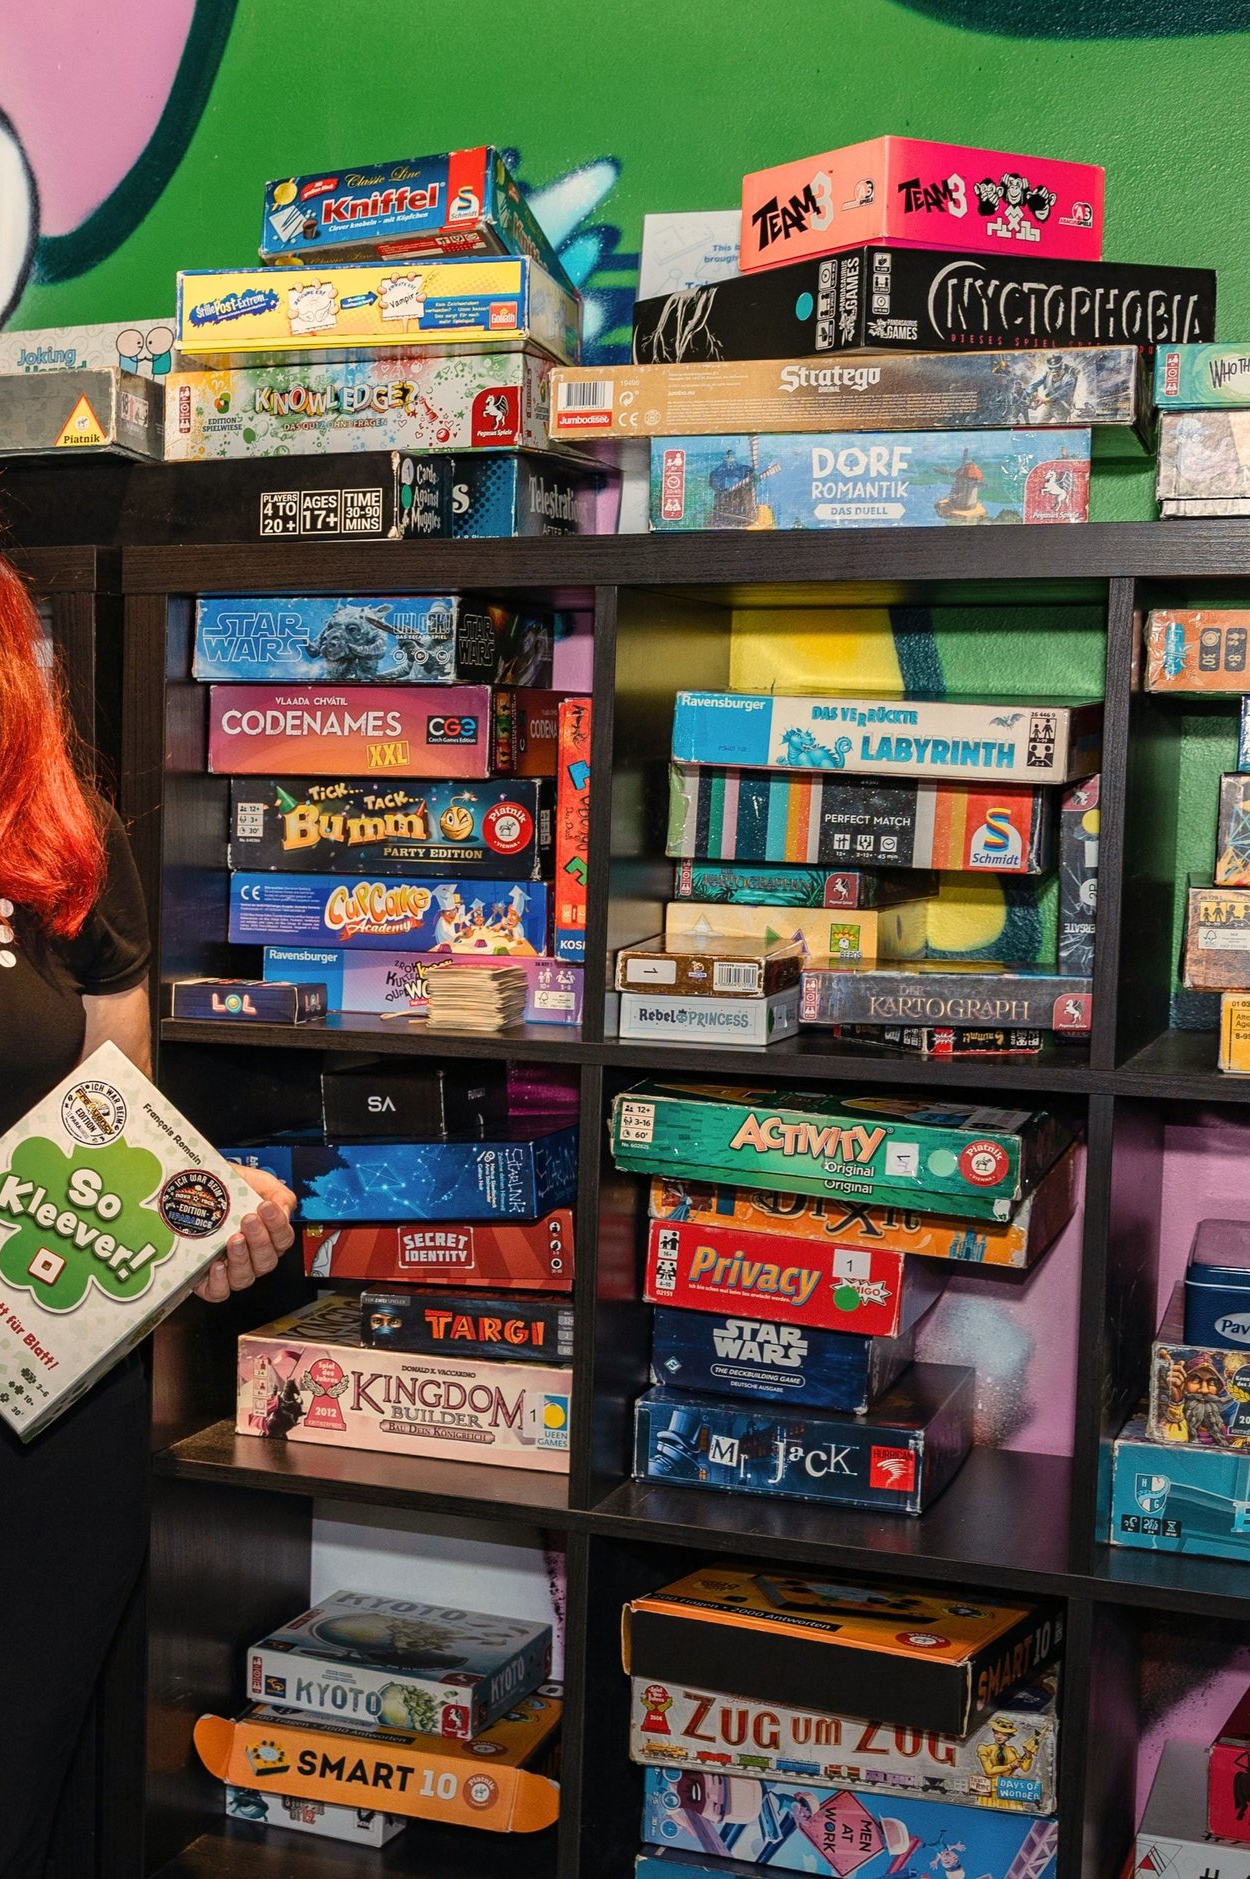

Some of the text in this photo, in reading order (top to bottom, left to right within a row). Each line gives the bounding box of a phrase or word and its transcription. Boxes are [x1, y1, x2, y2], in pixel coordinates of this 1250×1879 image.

[344, 172, 385, 189] Classic
[389, 166, 421, 182] Line
[321, 182, 440, 224] Kniffel
[329, 212, 428, 232] Clever knobeln mit Köpfchen
[450, 210, 478, 220] Schmidt
[712, 244, 733, 252] This
[845, 257, 860, 309] GAMES
[887, 319, 918, 327] PANDASAURUS
[887, 326, 918, 340] GAMES
[16, 346, 77, 367] Joking
[777, 365, 882, 393] Stratego
[254, 380, 421, 417] KNOWLEDGE?
[202, 423, 242, 433] SPIELWIESE
[208, 417, 237, 425] EDITION
[559, 415, 609, 426] Jumbodiset
[63, 433, 101, 444] Piatnik
[812, 446, 912, 478] DORF
[263, 493, 298, 503] PLAYERS
[811, 480, 909, 500] ROMANTIK
[304, 496, 337, 509] AGES
[344, 492, 380, 507] TIME
[263, 502, 297, 516] 4 TO
[346, 507, 380, 518] 30-90
[831, 506, 888, 516] DAS DUELL
[303, 511, 338, 529] 17+
[345, 518, 380, 530] MINS
[203, 612, 310, 637] STAR
[203, 637, 310, 662] WARS
[275, 695, 348, 706] VLAADA CHVÁTIL
[681, 695, 766, 711] Ravensburger
[221, 709, 402, 737] CODENAMES
[811, 706, 919, 728] DAS VERRÜCKTE
[368, 743, 409, 767] XXL
[860, 732, 1016, 769] LABYRINTH
[490, 805, 527, 824] Piatnik
[825, 814, 911, 827] PERFECT MATCH
[383, 847, 483, 859] PARTY EDITION
[971, 853, 1019, 866] Schmidt
[346, 920, 412, 933] Academy
[269, 949, 338, 963] Ravensburger
[639, 1007, 749, 1028] Rebel PRINCESS
[870, 996, 1030, 1021] KARTOGRAPH
[91, 1083, 124, 1125] ICH WAR BEIM
[638, 1106, 651, 1114] 12+
[74, 1107, 97, 1133] EDITION
[635, 1118, 651, 1127] 3-16
[143, 1102, 202, 1166] François Romain
[729, 1113, 888, 1163] ACTIVITY
[965, 1143, 1003, 1161] Piatnik
[824, 1161, 875, 1177] Original
[68, 1167, 122, 1221] So
[403, 1233, 468, 1249] SECRET
[405, 1250, 468, 1262] IDENTITY
[688, 1246, 822, 1306] Privacy
[424, 1309, 545, 1346] TARGI
[712, 1318, 808, 1349] STAR
[5, 1315, 25, 1335] für
[23, 1333, 60, 1371] Blatt!
[712, 1337, 808, 1368] WARS
[317, 1362, 335, 1371] Spiel
[714, 1366, 801, 1384] THE DECKBUILDING GAME
[315, 1374, 339, 1383] Jahres
[730, 1380, 784, 1393] DEUTSCHE AUSGABE
[35, 1383, 49, 1398] 3-6
[350, 1370, 527, 1430] KINGDOM
[315, 1406, 337, 1418] 2012
[391, 1405, 482, 1429] BUILDER
[388, 1423, 487, 1443] BAU DEIN KÖNIGREICH
[537, 1438, 568, 1448] GAMES
[337, 1593, 467, 1621] KYOTO
[490, 1657, 525, 1703] KYOTO
[295, 1677, 381, 1716] KYOTO
[297, 1750, 459, 1801] SMART 10
[858, 1819, 872, 1854] MEN
